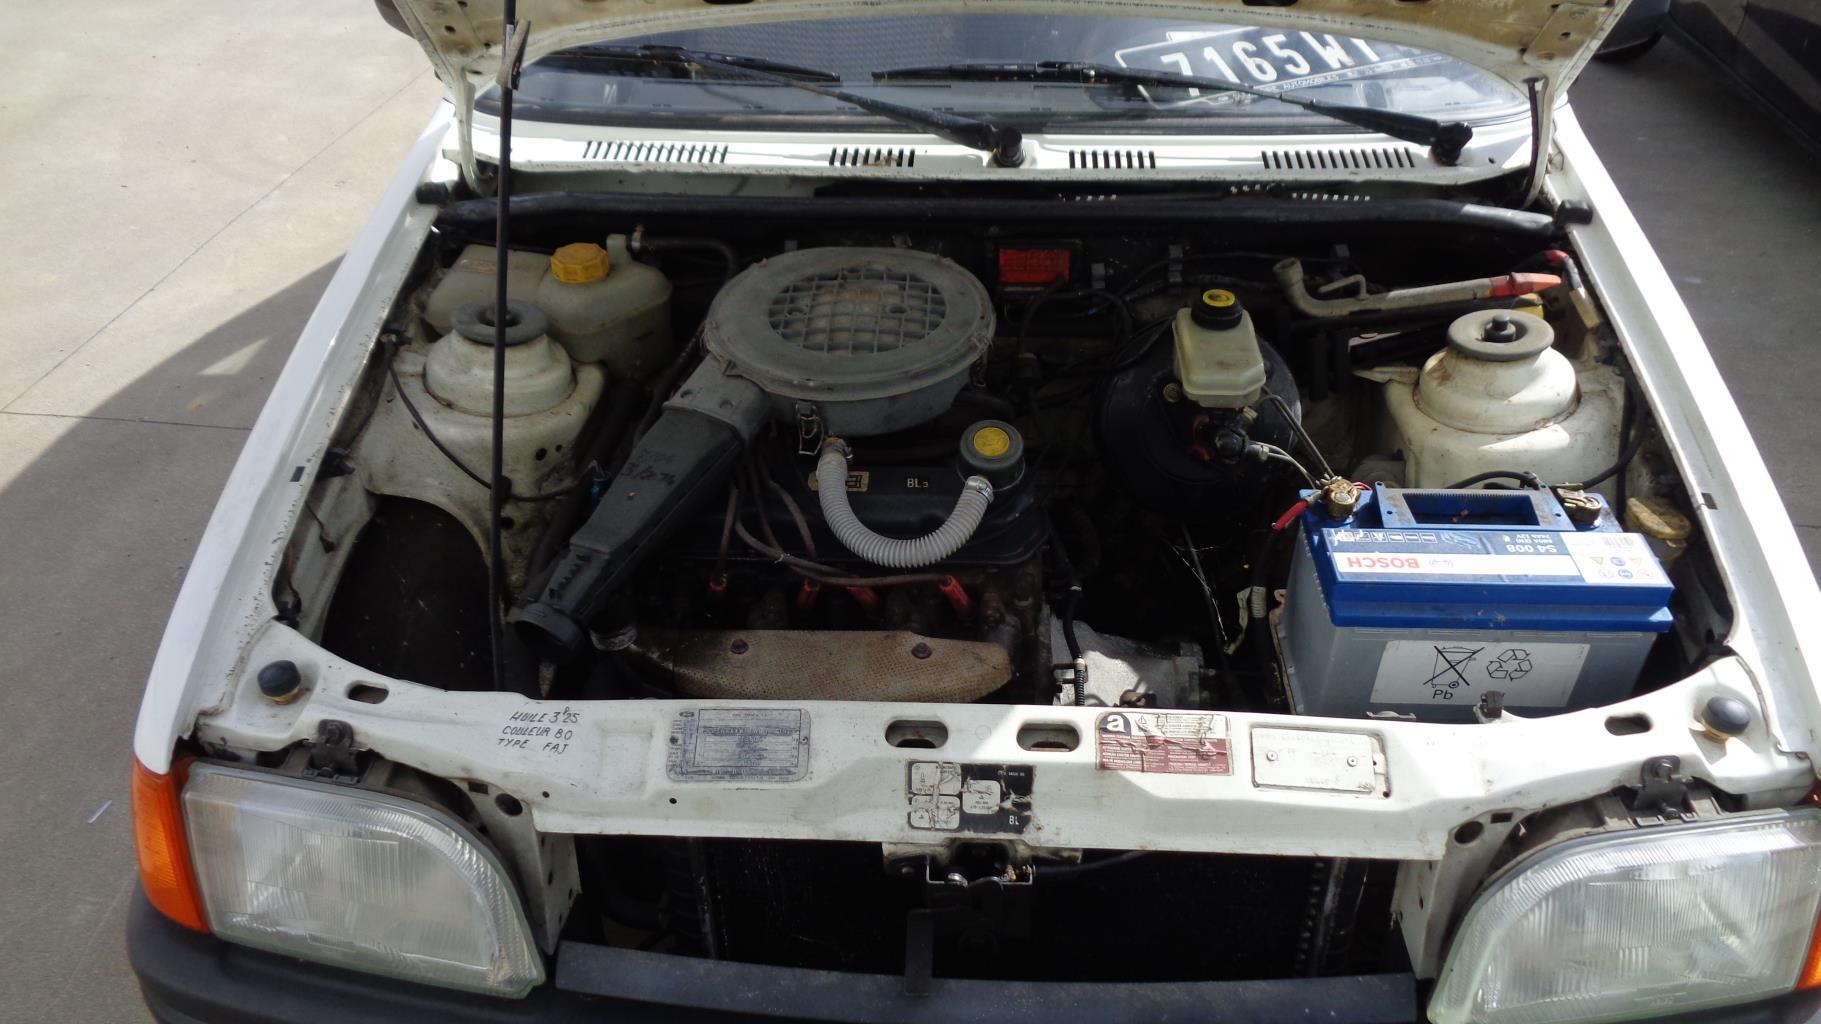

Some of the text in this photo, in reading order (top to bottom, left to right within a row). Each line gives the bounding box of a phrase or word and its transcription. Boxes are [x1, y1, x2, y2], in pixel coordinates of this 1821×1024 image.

[1347, 557, 1420, 570] BOSCH
[1432, 689, 1454, 700] Pb
[509, 711, 547, 722] HUILE
[502, 725, 551, 737] COULEUR
[498, 738, 530, 749] TYPE
